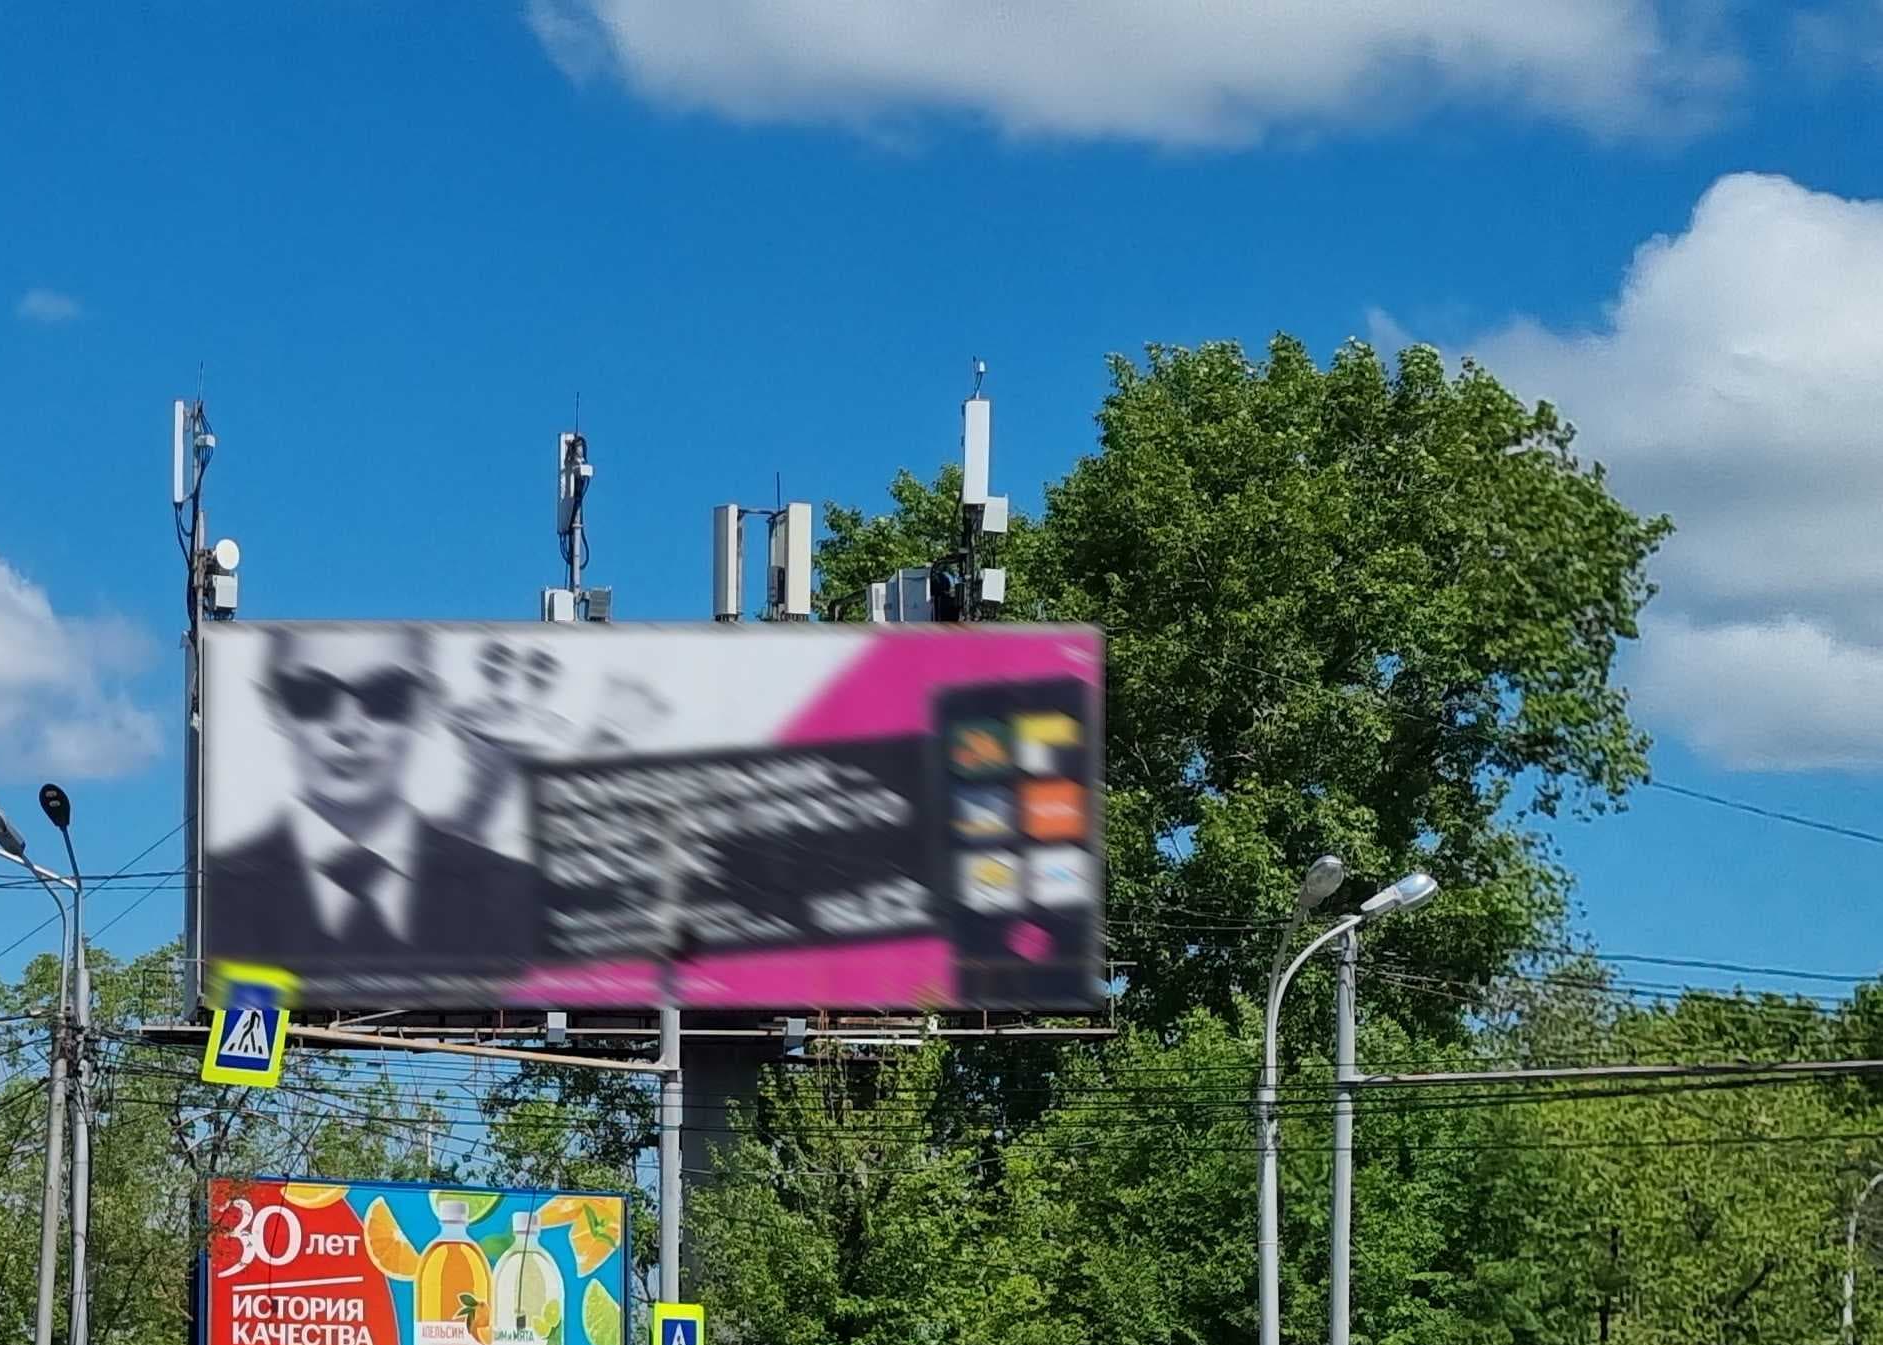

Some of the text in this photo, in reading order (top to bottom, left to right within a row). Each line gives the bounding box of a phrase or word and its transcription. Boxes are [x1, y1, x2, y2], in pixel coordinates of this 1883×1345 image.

[217, 1198, 361, 1278] 30 лет
[232, 1294, 364, 1322] ИСТОРИЯ
